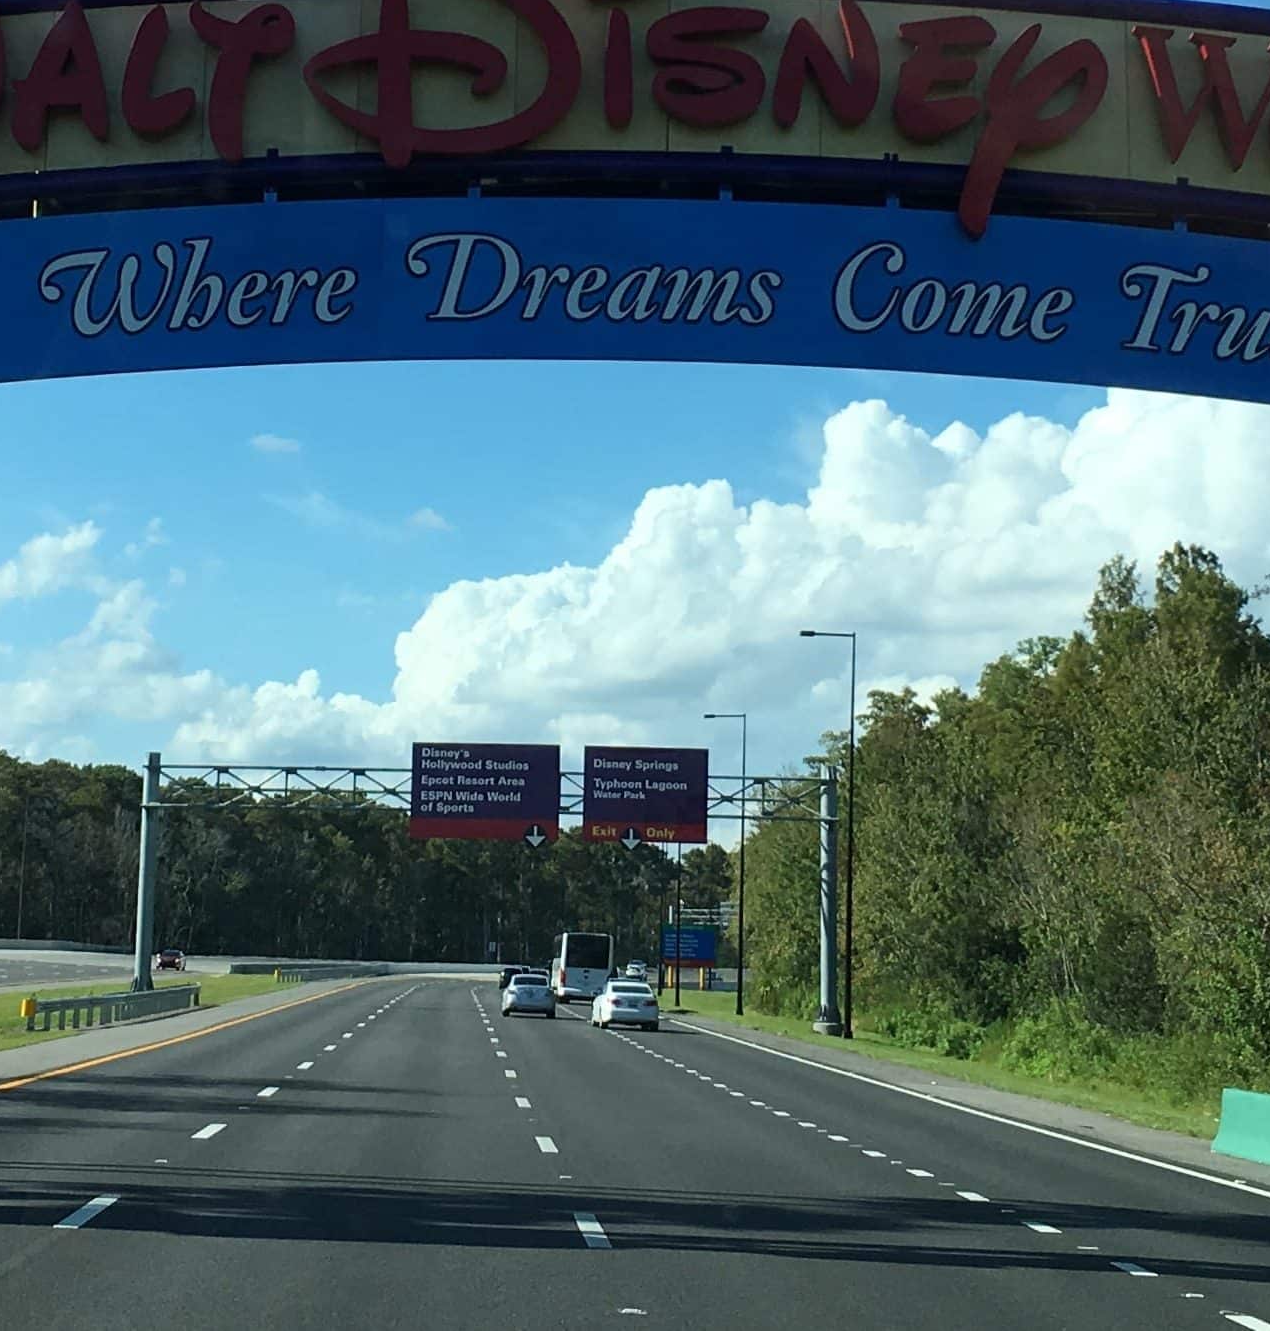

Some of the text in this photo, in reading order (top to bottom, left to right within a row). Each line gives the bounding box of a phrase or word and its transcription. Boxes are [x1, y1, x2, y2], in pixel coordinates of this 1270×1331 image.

[40, 236, 358, 337] Where
[406, 232, 782, 326] Dreams
[834, 241, 1074, 341] Come
[421, 747, 470, 759] Disney's
[421, 759, 530, 771] Hollywood Studios
[593, 758, 679, 772] Disney Springs
[421, 774, 526, 787] Epcot Resort Area
[593, 778, 688, 792] Typhoon Lagoon
[420, 790, 522, 802] ESPN Wide World
[593, 790, 646, 800] Water Park
[420, 802, 475, 814] of Sports
[592, 825, 675, 839] Exit Only
